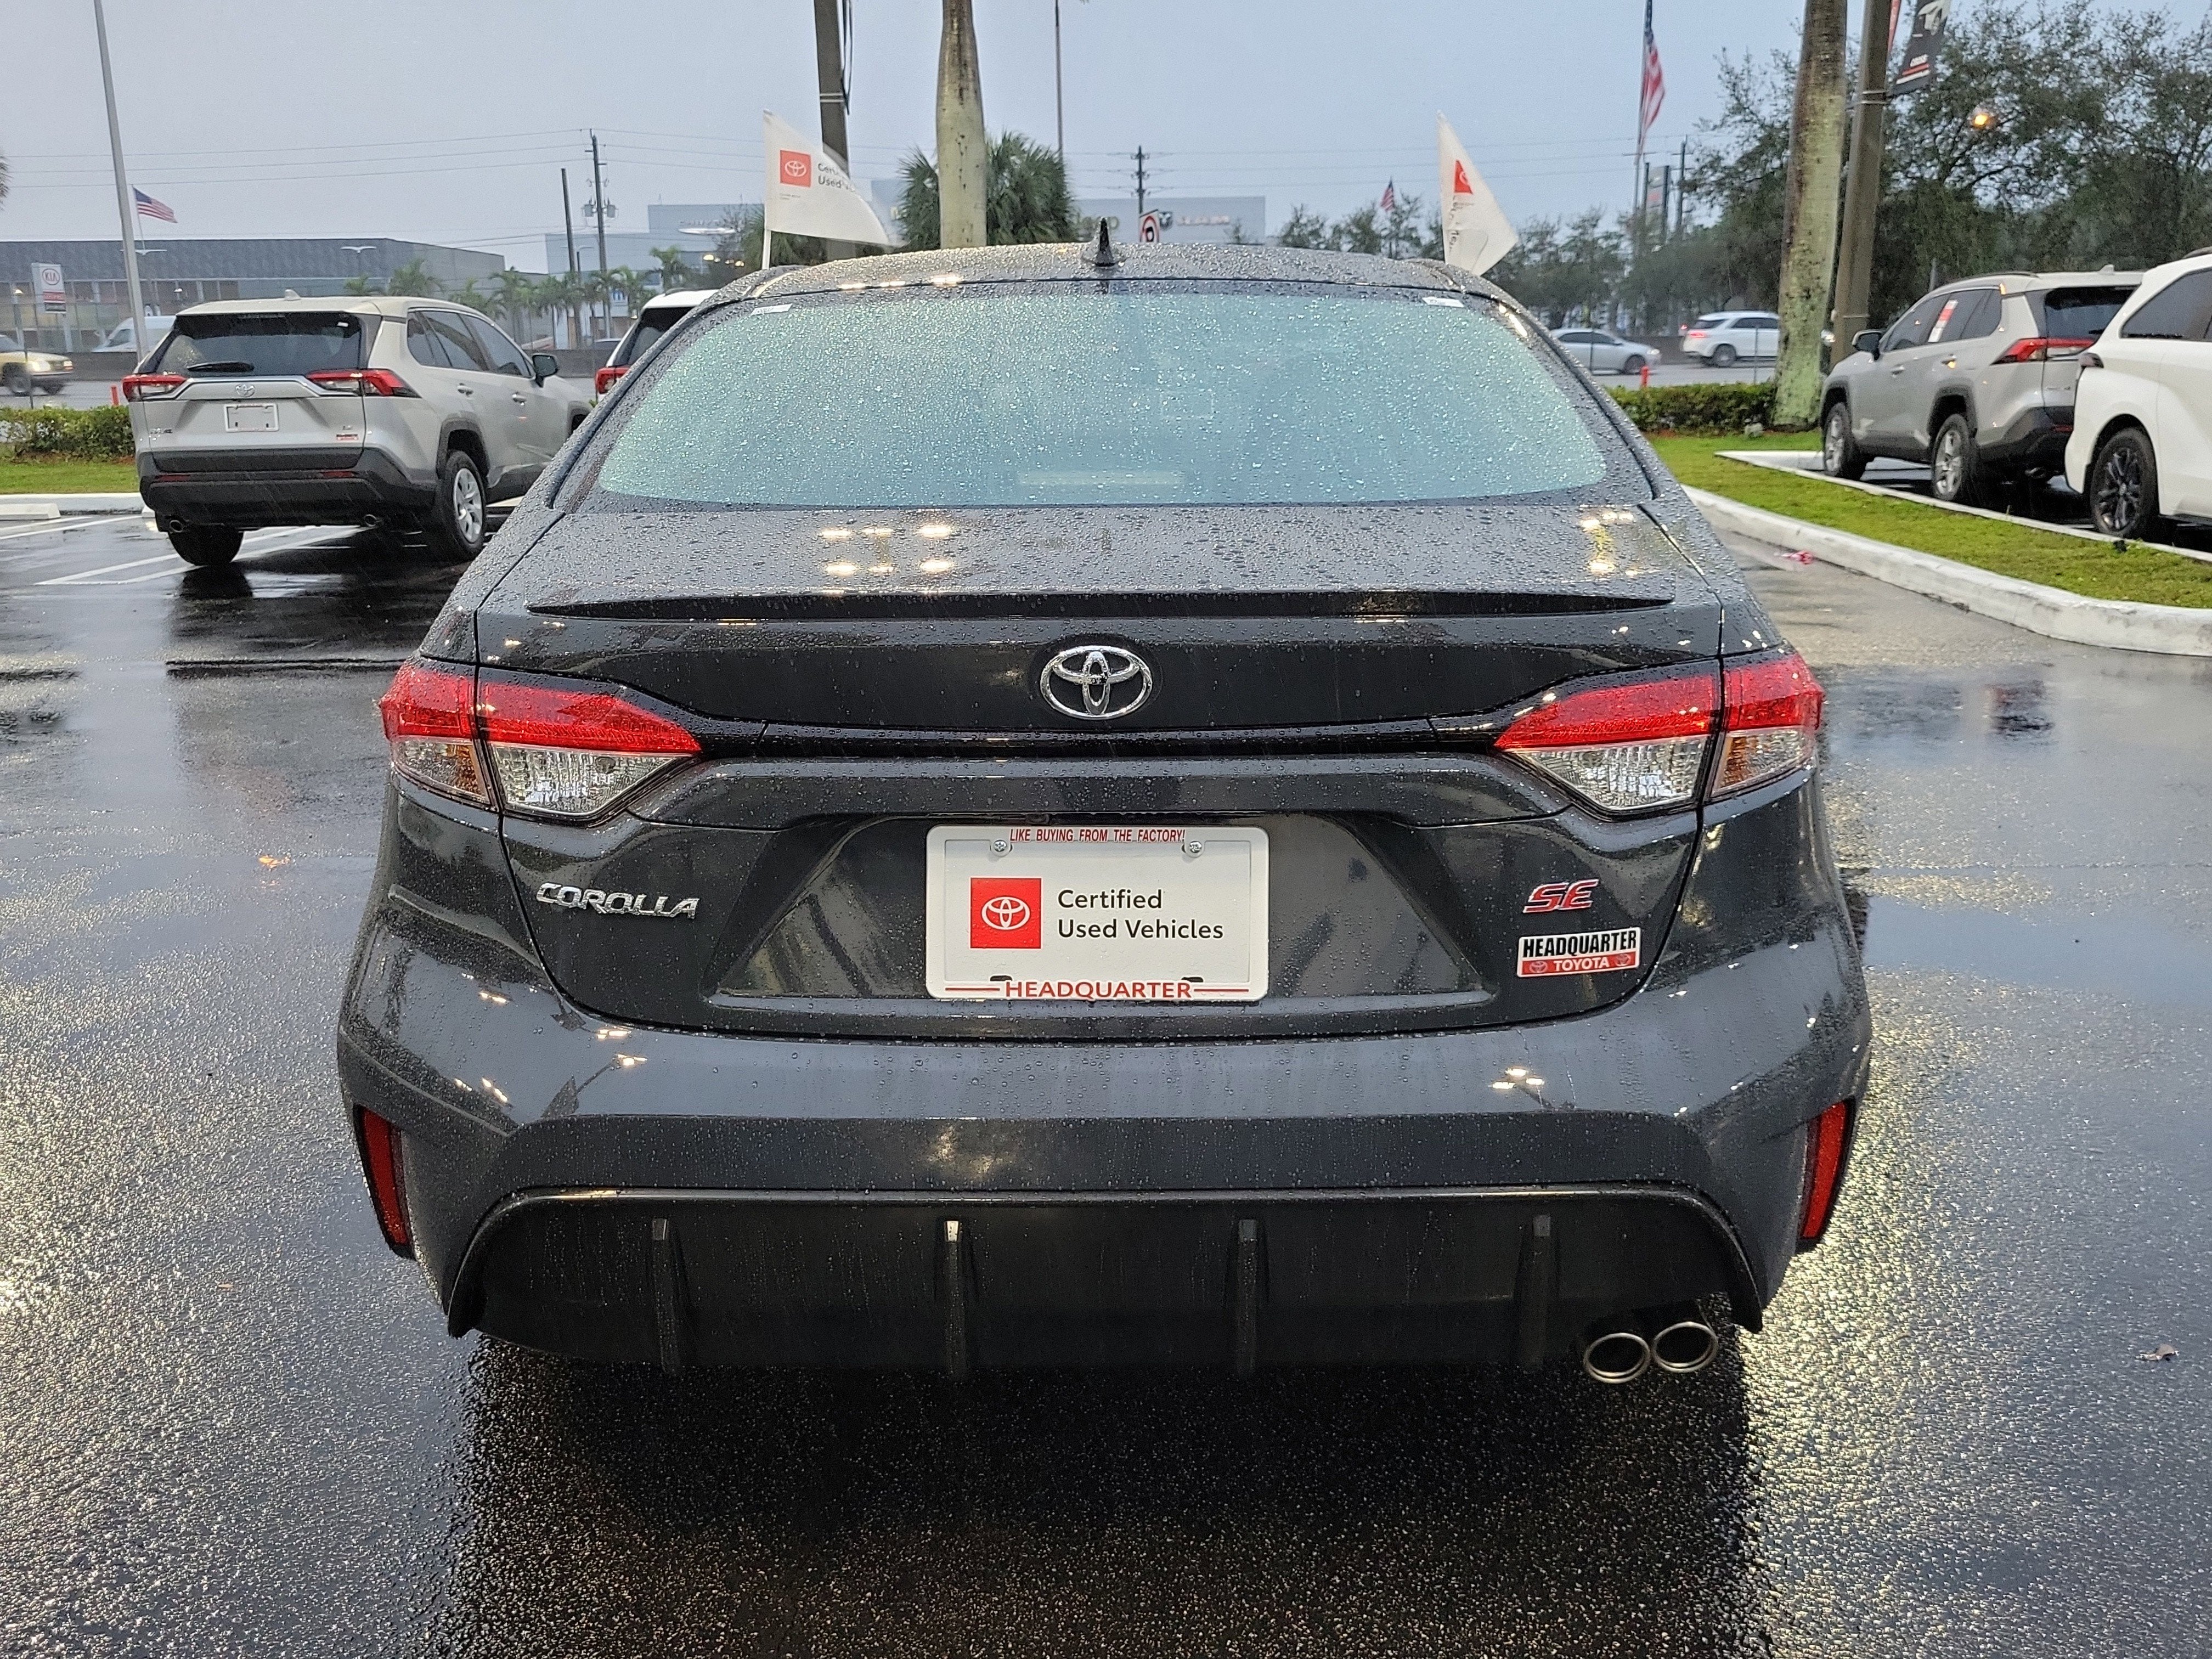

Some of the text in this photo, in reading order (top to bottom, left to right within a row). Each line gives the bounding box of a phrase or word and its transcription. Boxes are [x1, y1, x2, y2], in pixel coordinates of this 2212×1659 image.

[45, 272, 59, 281] KIA
[1010, 828, 1186, 842] LIKE BUYING FROM THE FACTORY!
[537, 882, 700, 919] COROLLA
[1058, 889, 1163, 909] Certified
[1522, 879, 1600, 913] SE
[1058, 918, 1223, 939] Used Vehicles
[1523, 930, 1637, 957] HEADQUARTER
[1553, 956, 1610, 972] TOYOTA
[1006, 981, 1192, 1001] HEADQUARTER
